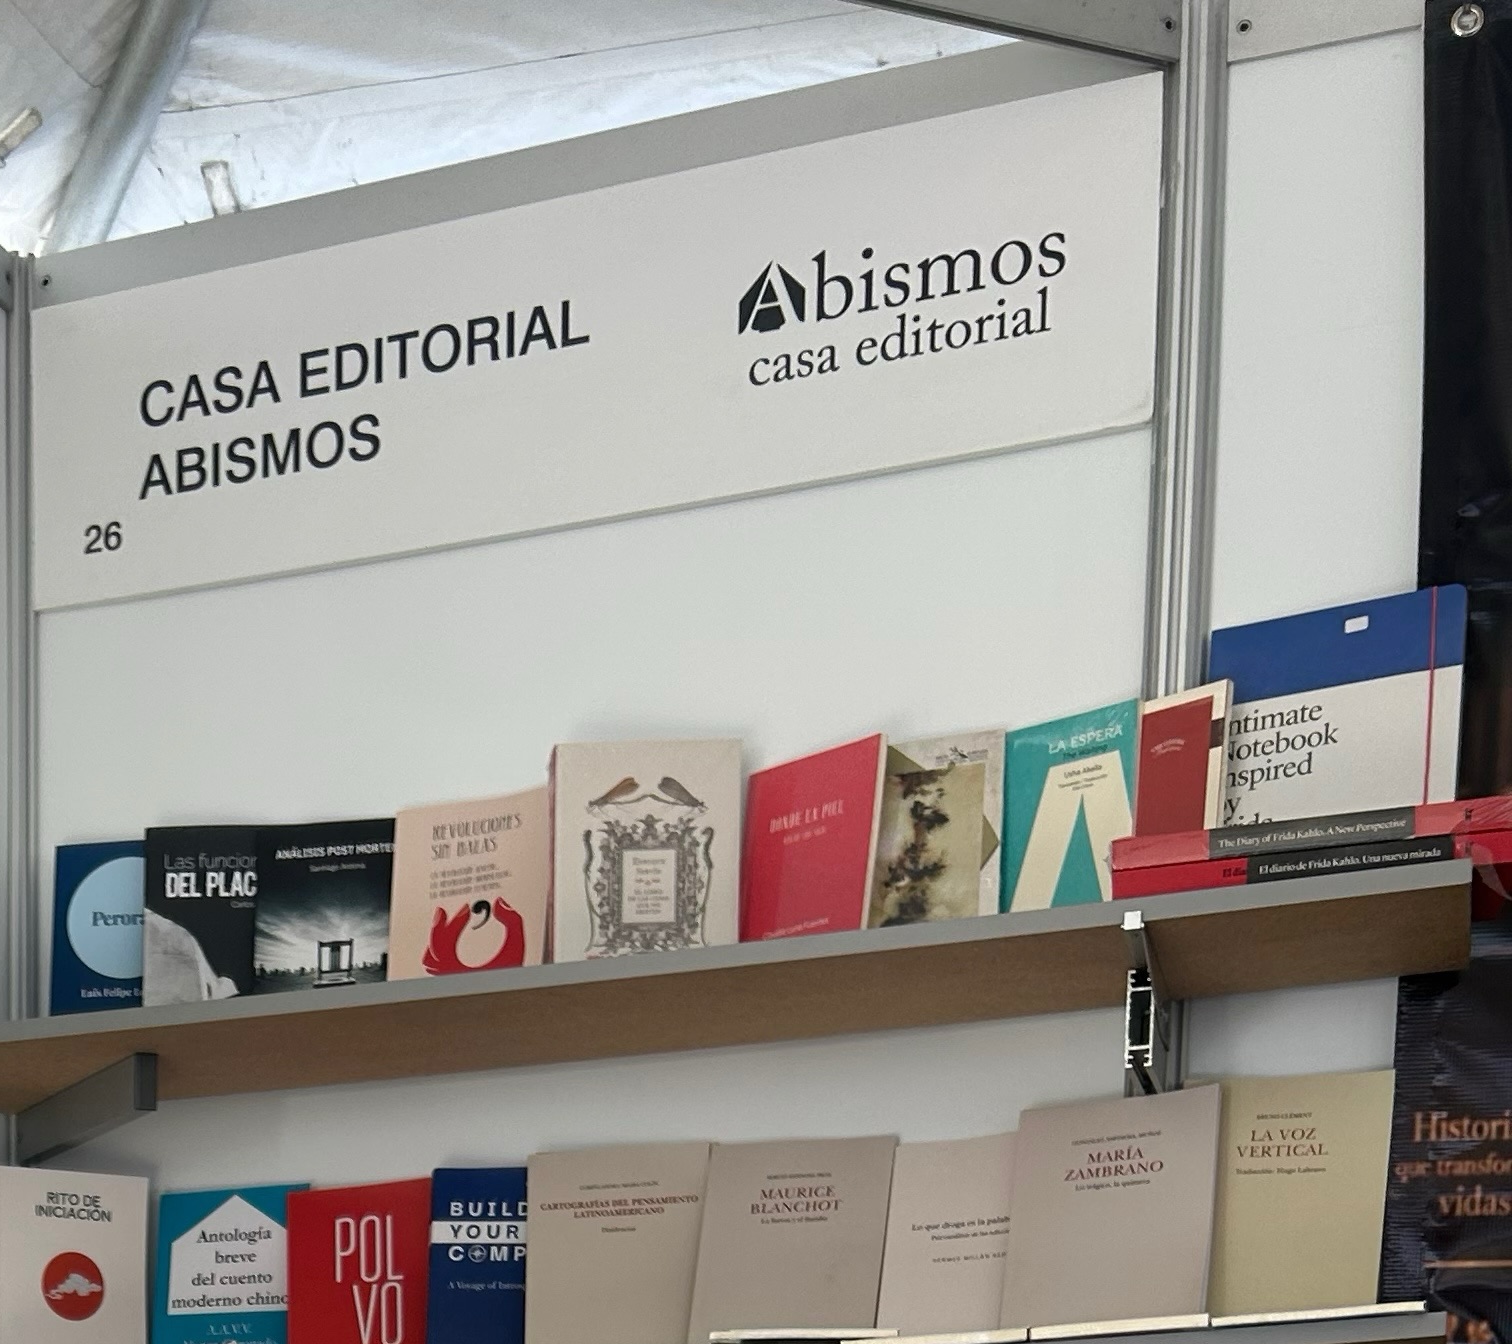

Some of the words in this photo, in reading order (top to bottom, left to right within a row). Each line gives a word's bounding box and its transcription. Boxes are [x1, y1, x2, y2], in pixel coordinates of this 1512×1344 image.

[738, 229, 1068, 335] Abismos
[747, 335, 839, 386] casa
[855, 286, 1051, 369] editorial
[140, 358, 279, 428] CASA
[299, 297, 590, 396] EDITORIAL
[140, 412, 382, 500] ABISMOS
[84, 520, 123, 555] 26
[1049, 740, 1066, 754] LA
[1071, 724, 1123, 749] ESPERA
[770, 811, 801, 833] DONDE
[805, 806, 818, 823] LA
[822, 799, 843, 819] PIEL
[432, 813, 522, 841] REVOLUCIONES
[1218, 838, 1236, 849] The
[1237, 834, 1261, 849] Diary
[1262, 833, 1272, 844] of
[1273, 829, 1295, 843] Frida
[1335, 822, 1355, 835] New
[1356, 818, 1407, 834] Perspective
[327, 845, 354, 856] POST
[431, 843, 450, 860] SIN
[456, 836, 498, 857] BALAS
[164, 853, 195, 870] Las
[1258, 864, 1268, 875] El
[1268, 860, 1294, 874] diario
[1295, 859, 1306, 871] de
[1308, 856, 1331, 869] Frida
[1362, 852, 1380, 864] Una
[1382, 851, 1408, 863] nueva
[1409, 846, 1441, 859] mirada
[166, 872, 201, 898] DEL
[205, 871, 257, 897] PLAC
[1251, 1129, 1275, 1142] LA
[1279, 1127, 1317, 1141] VOZ
[1087, 1145, 1144, 1164] MARÍA
[1236, 1143, 1329, 1159] VERTICAL
[1064, 1160, 1164, 1182] ZAMBRANO
[46, 1191, 79, 1206] RITO
[83, 1194, 102, 1208] DE
[612, 1199, 629, 1208] DEL
[631, 1194, 699, 1206] PENSAMIENTO
[760, 1185, 836, 1201] MAURICE
[35, 1204, 112, 1223] INICIACIÓN
[450, 1201, 527, 1217] BUILD
[750, 1199, 843, 1215] BLANCHOT
[196, 1227, 272, 1245] Antología
[450, 1224, 519, 1239] YOUR
[215, 1251, 257, 1264] breve
[334, 1214, 404, 1283] POL
[192, 1272, 216, 1287] del
[219, 1271, 273, 1285] cuento
[458, 1280, 486, 1292] Voyage
[488, 1280, 497, 1290] of
[172, 1292, 242, 1308] moderno
